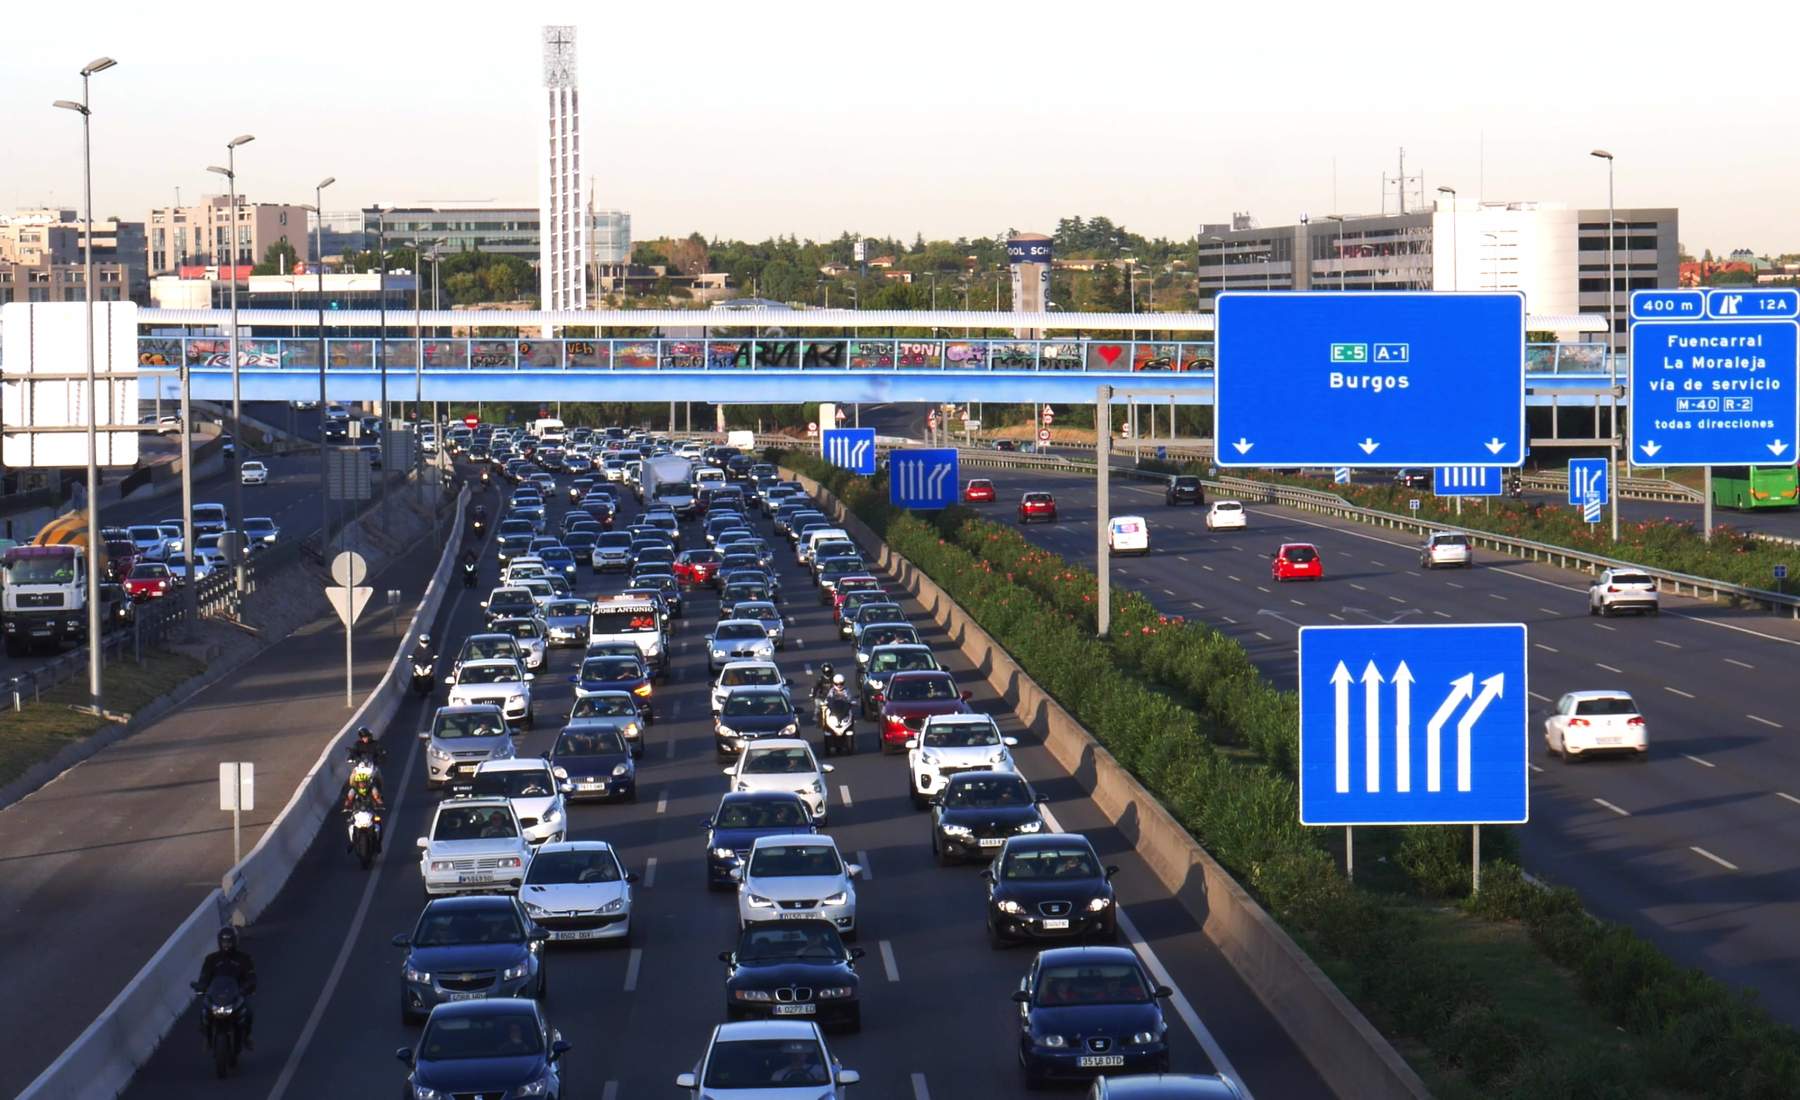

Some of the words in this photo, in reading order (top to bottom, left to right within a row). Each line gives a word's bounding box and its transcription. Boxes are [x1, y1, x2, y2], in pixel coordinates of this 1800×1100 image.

[1643, 299, 1674, 311] 400
[1681, 301, 1693, 310] m
[1759, 299, 1787, 310] 12A
[1668, 334, 1762, 348] Fuencarral
[1333, 345, 1365, 360] E-5
[1377, 345, 1406, 360] A-1
[1664, 356, 1684, 369] La
[1692, 356, 1767, 371] Moraleja
[1330, 371, 1410, 393] Burgos
[1683, 377, 1703, 390] de
[1712, 377, 1781, 390] servicio
[1678, 398, 1718, 410] M-40
[1725, 398, 1751, 410] R-2
[1655, 419, 1692, 429] todas
[1698, 418, 1774, 429] direcciones
[617, 605, 654, 613] ANTONIO
